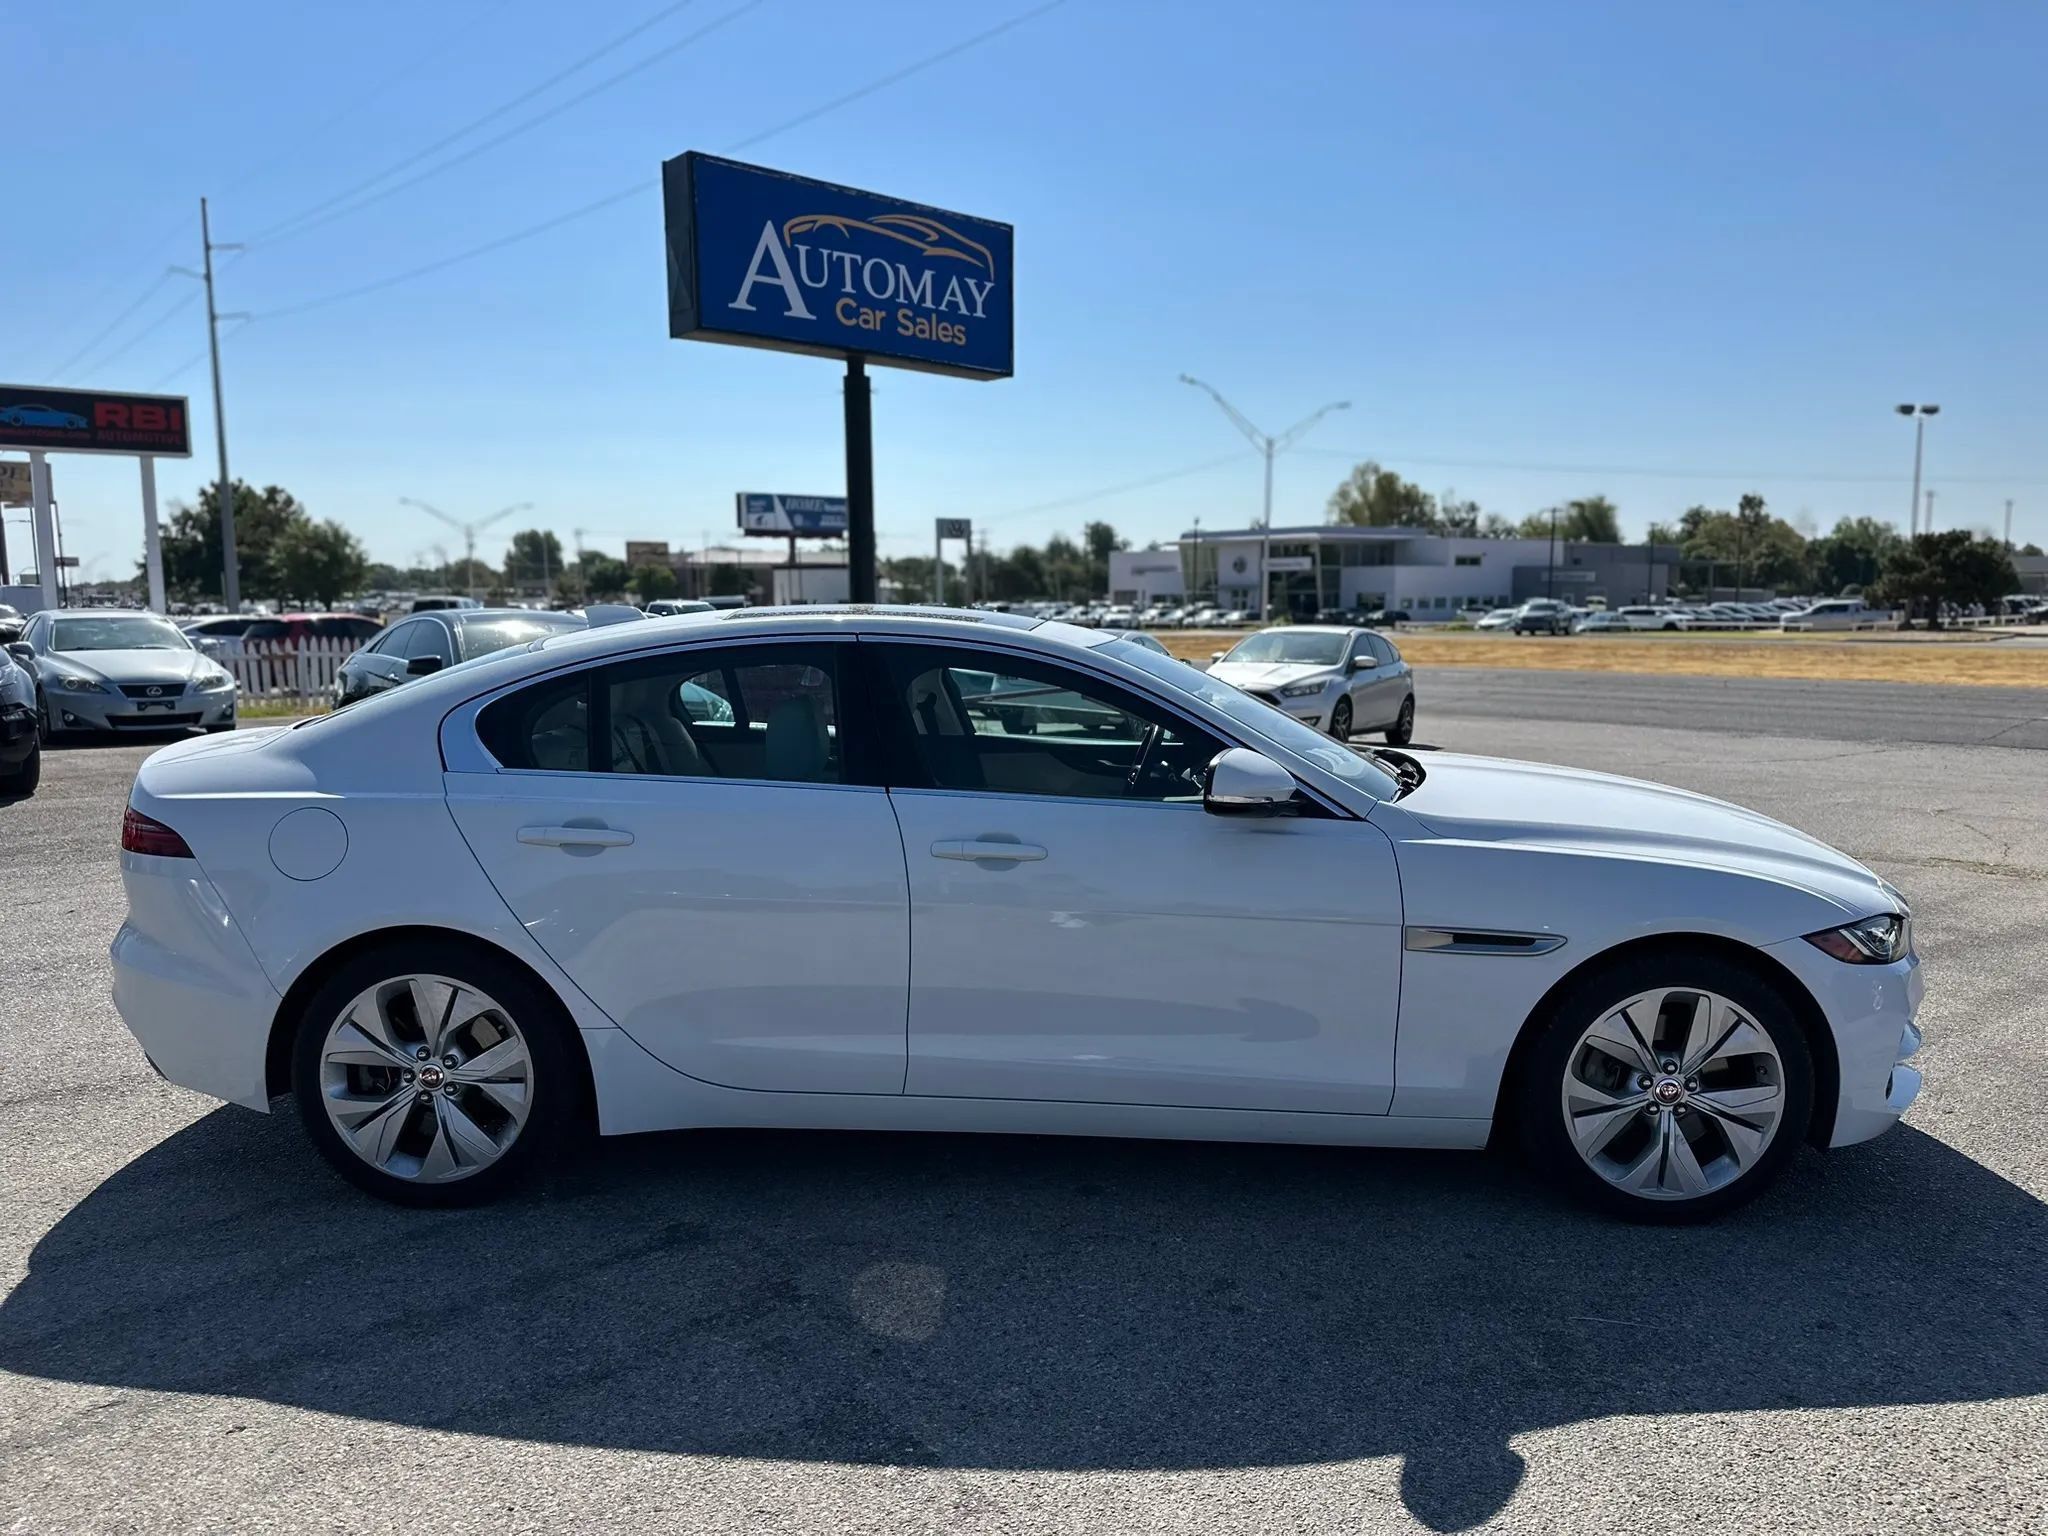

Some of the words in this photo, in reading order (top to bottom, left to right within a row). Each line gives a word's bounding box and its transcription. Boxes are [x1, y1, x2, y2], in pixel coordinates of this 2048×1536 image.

[728, 220, 994, 320] AUTOMAY
[835, 297, 886, 331] Car
[897, 308, 966, 346] Sales
[94, 402, 182, 431] RBI
